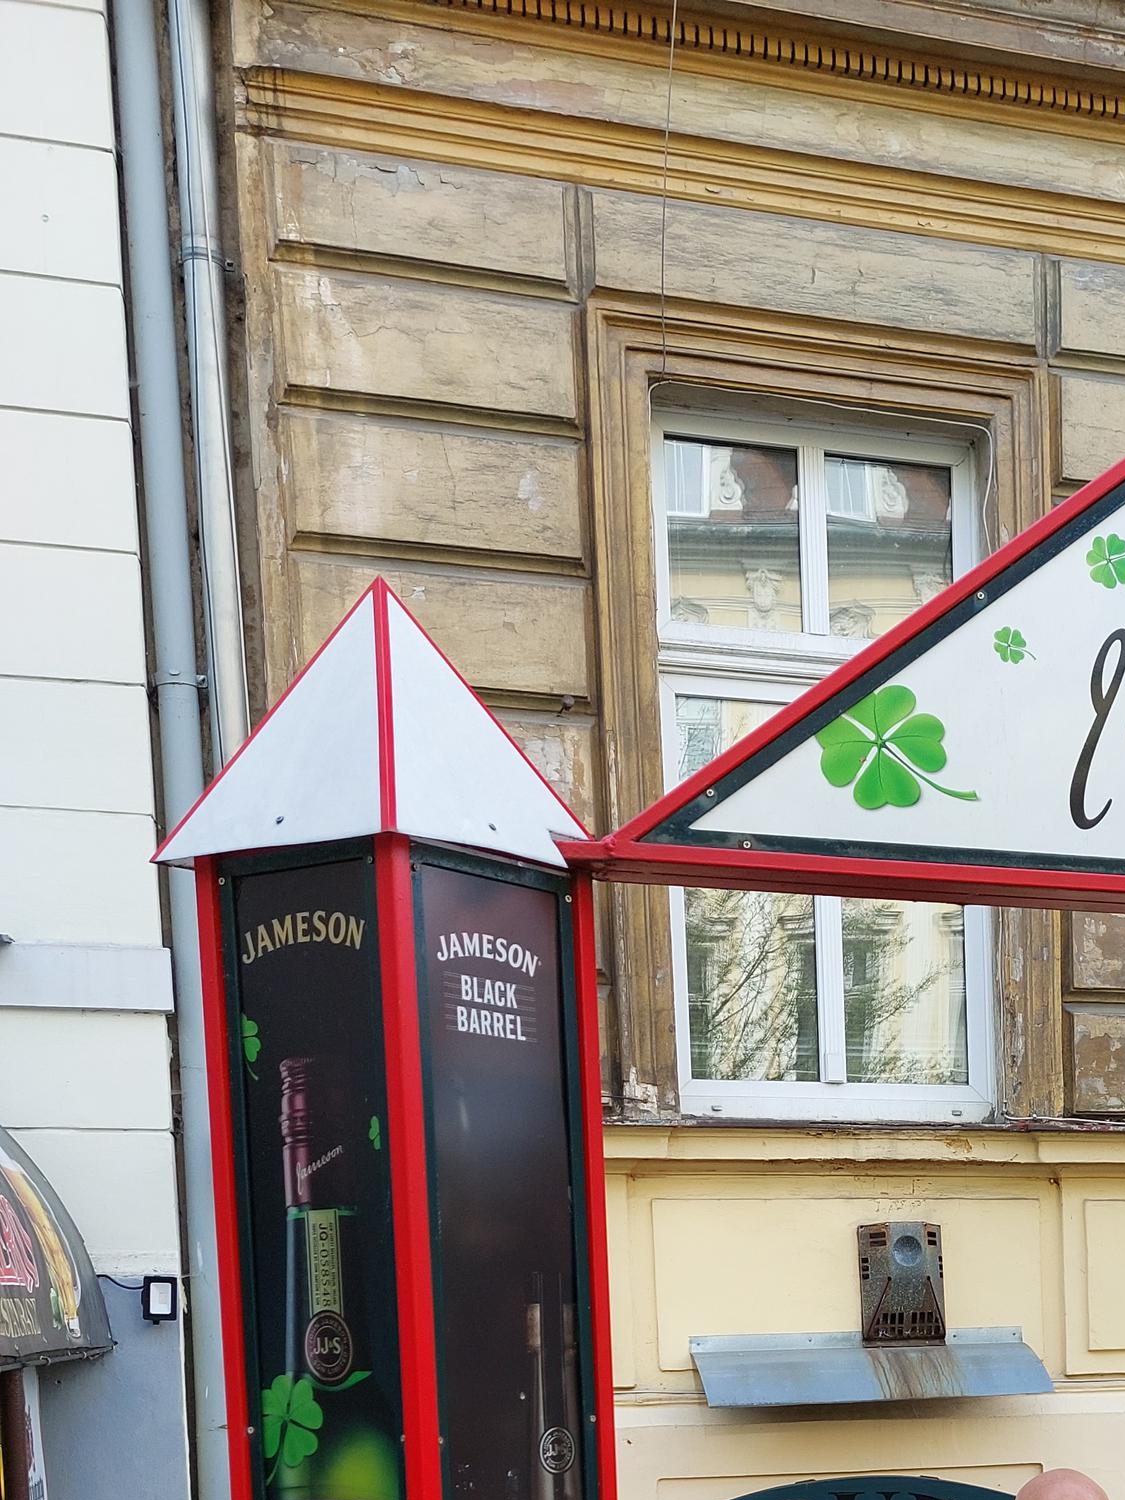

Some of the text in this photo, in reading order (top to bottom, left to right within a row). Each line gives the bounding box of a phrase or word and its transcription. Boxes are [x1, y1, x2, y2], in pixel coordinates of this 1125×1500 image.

[242, 910, 366, 964] JAMESON
[436, 932, 539, 978] JAMESON
[460, 974, 518, 1009] BLACK
[456, 1005, 527, 1041] BARREL
[295, 1144, 344, 1196] Jameson
